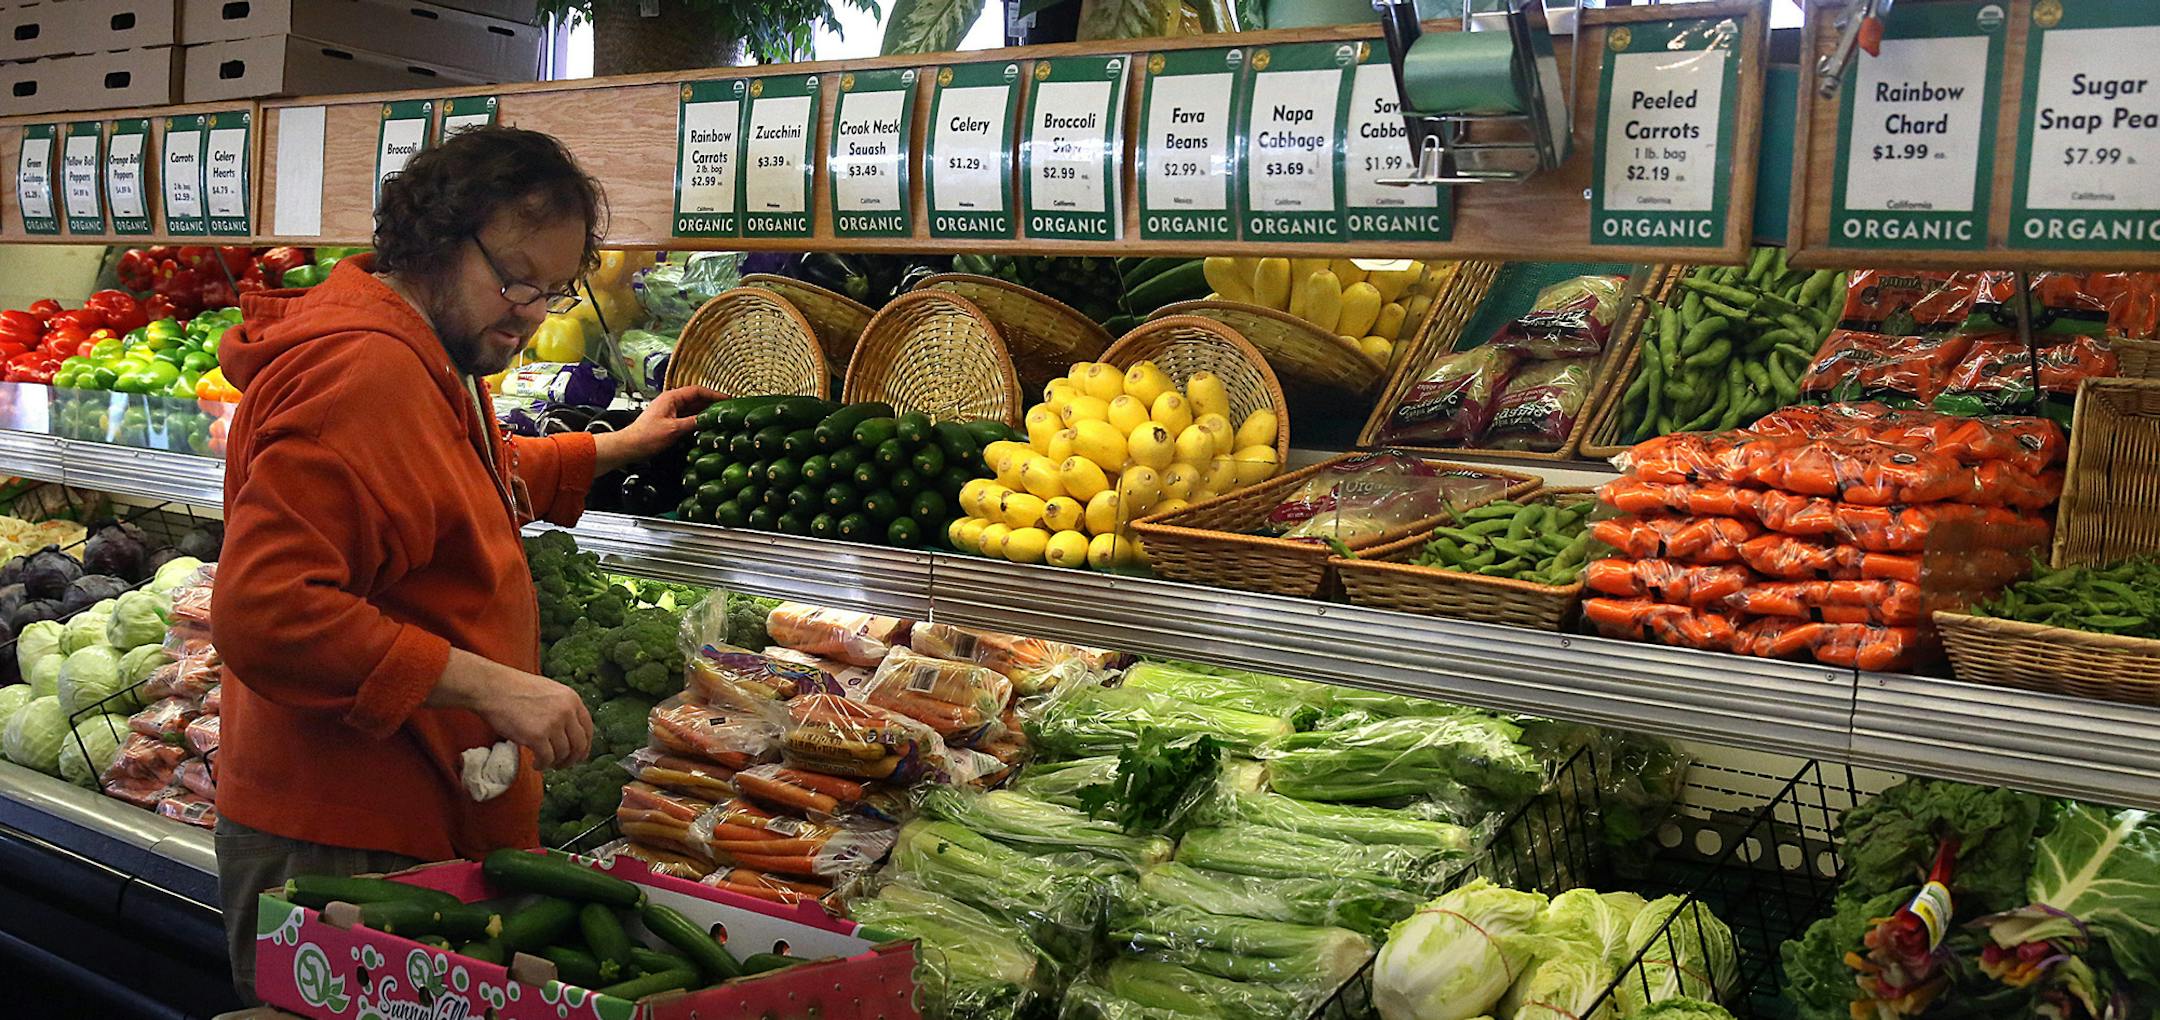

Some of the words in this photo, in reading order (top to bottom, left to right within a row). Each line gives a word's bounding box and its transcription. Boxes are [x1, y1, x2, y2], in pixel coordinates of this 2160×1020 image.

[1876, 81, 1964, 102] Rainbow
[2072, 73, 2148, 99] Sugar
[1374, 98, 1400, 114] Sav
[1631, 89, 1698, 110] Peeled
[1044, 113, 1096, 129] Broccoli
[1172, 107, 1205, 124] Fava
[1273, 104, 1313, 125] Napa
[2039, 108, 2102, 134] Snap
[2113, 107, 2158, 129] Pea
[840, 120, 870, 135] Crook
[873, 119, 900, 134] Neck
[950, 116, 990, 135] Celery
[1360, 122, 1407, 139] Cabba
[1625, 120, 1700, 140] Carrots
[1885, 113, 1948, 135] Chard
[690, 128, 732, 143] Rainbow
[756, 125, 801, 140] Zucchini
[387, 142, 417, 155] Broccoli
[849, 141, 886, 156] Squash
[1166, 133, 1208, 149] Beans
[1258, 131, 1325, 151] Cabbage
[108, 154, 129, 167] Orange
[170, 152, 194, 163] Carrots
[214, 150, 236, 164] Celery
[692, 150, 728, 164] Carrots
[1635, 147, 1639, 159] 1
[1645, 147, 1660, 159] lb.
[1663, 147, 1686, 162] bag
[1873, 144, 1928, 162] $1.99
[2064, 147, 2121, 167] $7.99
[696, 165, 700, 173] 2
[711, 165, 723, 174] bag
[758, 156, 784, 168] $3.39
[949, 157, 980, 170] $1.29
[1266, 162, 1304, 176] $3.69
[1365, 155, 1402, 171] $1.99
[69, 171, 91, 183] Peppers
[114, 170, 134, 181] Peppers
[213, 167, 236, 178] Hearts
[849, 165, 877, 177] $3.49
[1043, 167, 1075, 179] $2.99
[1164, 163, 1197, 177] $2.99
[1626, 165, 1669, 181] $2.19
[691, 176, 716, 187] $2.99
[2071, 191, 2115, 201] California
[1886, 199, 1933, 210] California
[26, 220, 55, 231] ORGANIC
[71, 220, 101, 231] ORGANIC
[116, 220, 146, 231] ORGANIC
[169, 220, 203, 232] ORGANIC
[211, 220, 248, 232] ORGANIC
[678, 218, 734, 232] ORGANIC
[747, 218, 807, 232] ORGANIC
[839, 216, 903, 231] ORGANIC
[936, 217, 1006, 232] ORGANIC
[1031, 216, 1107, 234] ORGANIC
[1147, 217, 1229, 233] ORGANIC
[1250, 217, 1338, 234] ORGANIC
[1349, 215, 1440, 233] ORGANIC
[1602, 218, 1712, 238] ORGANIC
[1842, 218, 1973, 241] ORGANIC
[2024, 218, 2160, 241] ORGANIC
